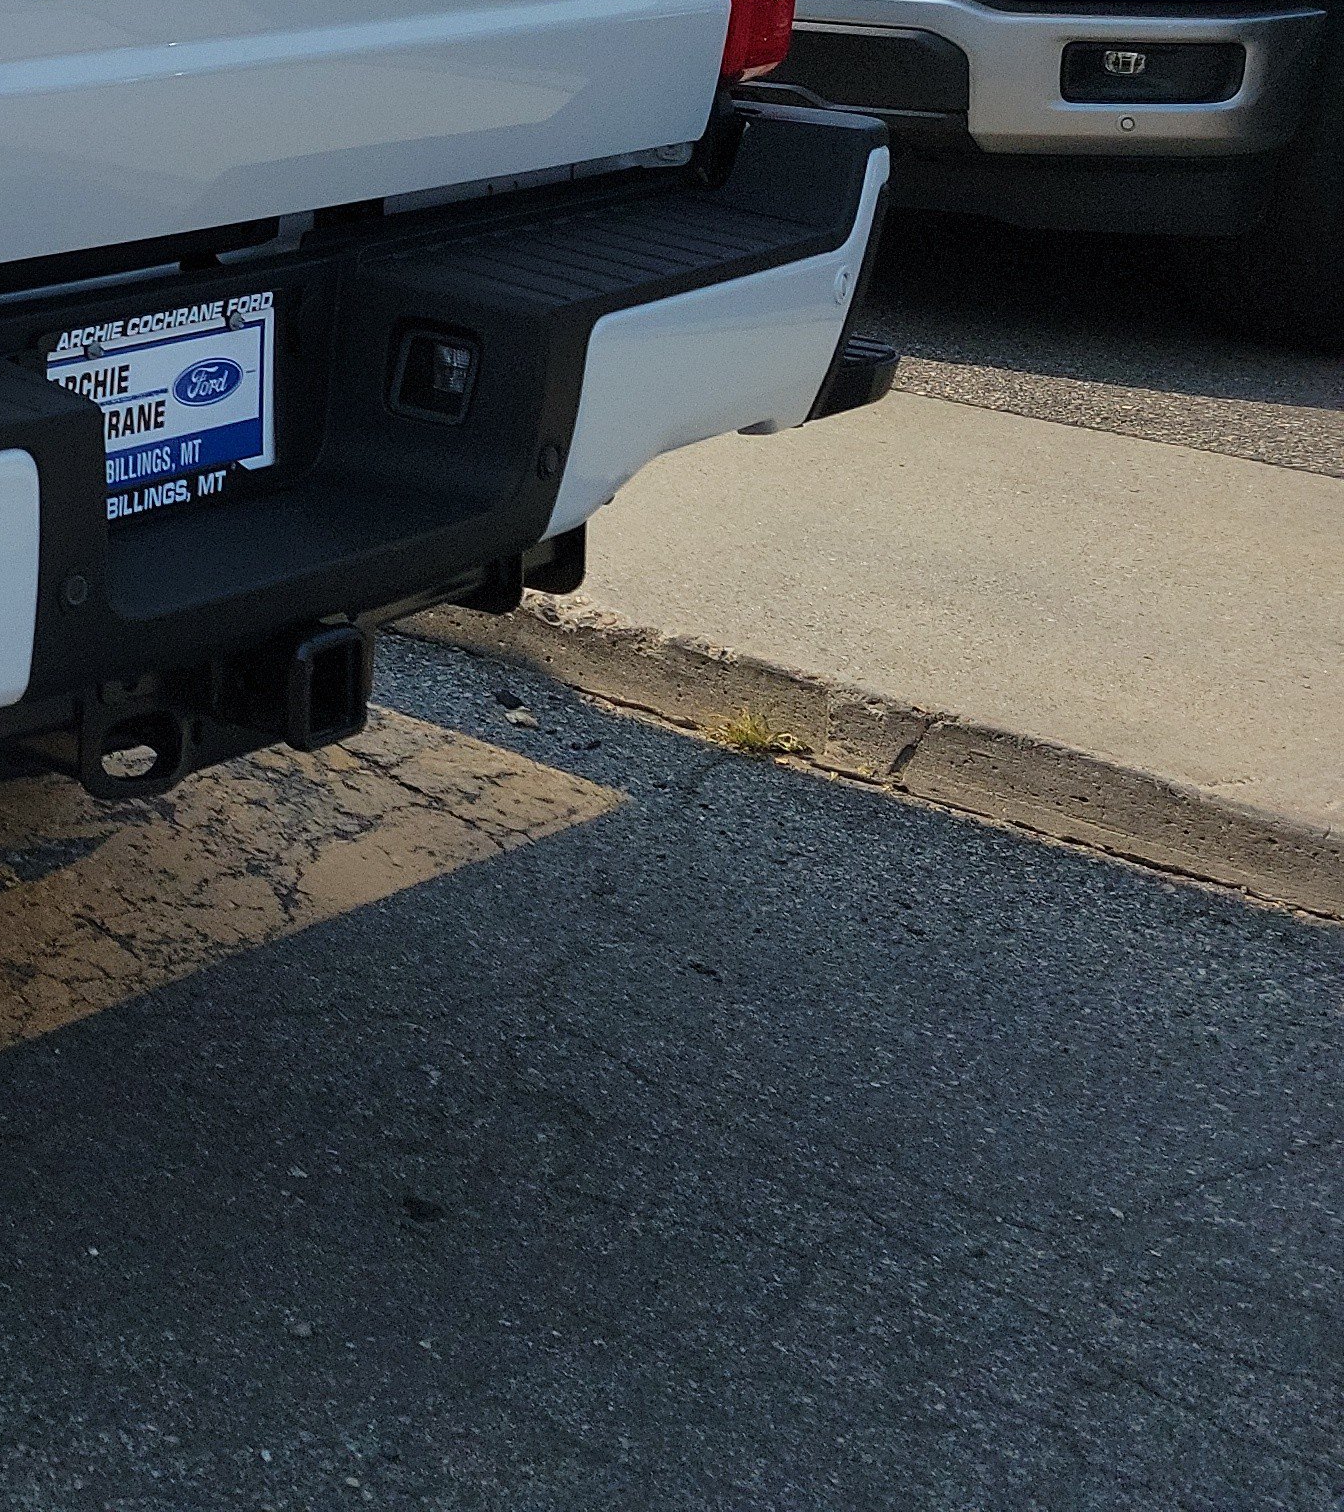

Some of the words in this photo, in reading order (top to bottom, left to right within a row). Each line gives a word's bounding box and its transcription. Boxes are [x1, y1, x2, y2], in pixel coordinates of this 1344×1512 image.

[56, 320, 124, 351] ARCHIE
[126, 300, 224, 336] COCHRANE
[227, 291, 273, 316] FORD
[188, 365, 228, 399] Ford
[108, 399, 166, 440] RANE
[106, 446, 176, 484] BILLINGS,
[180, 439, 202, 466] MT
[106, 479, 192, 520] BILLINGS,
[198, 470, 226, 497] MT
